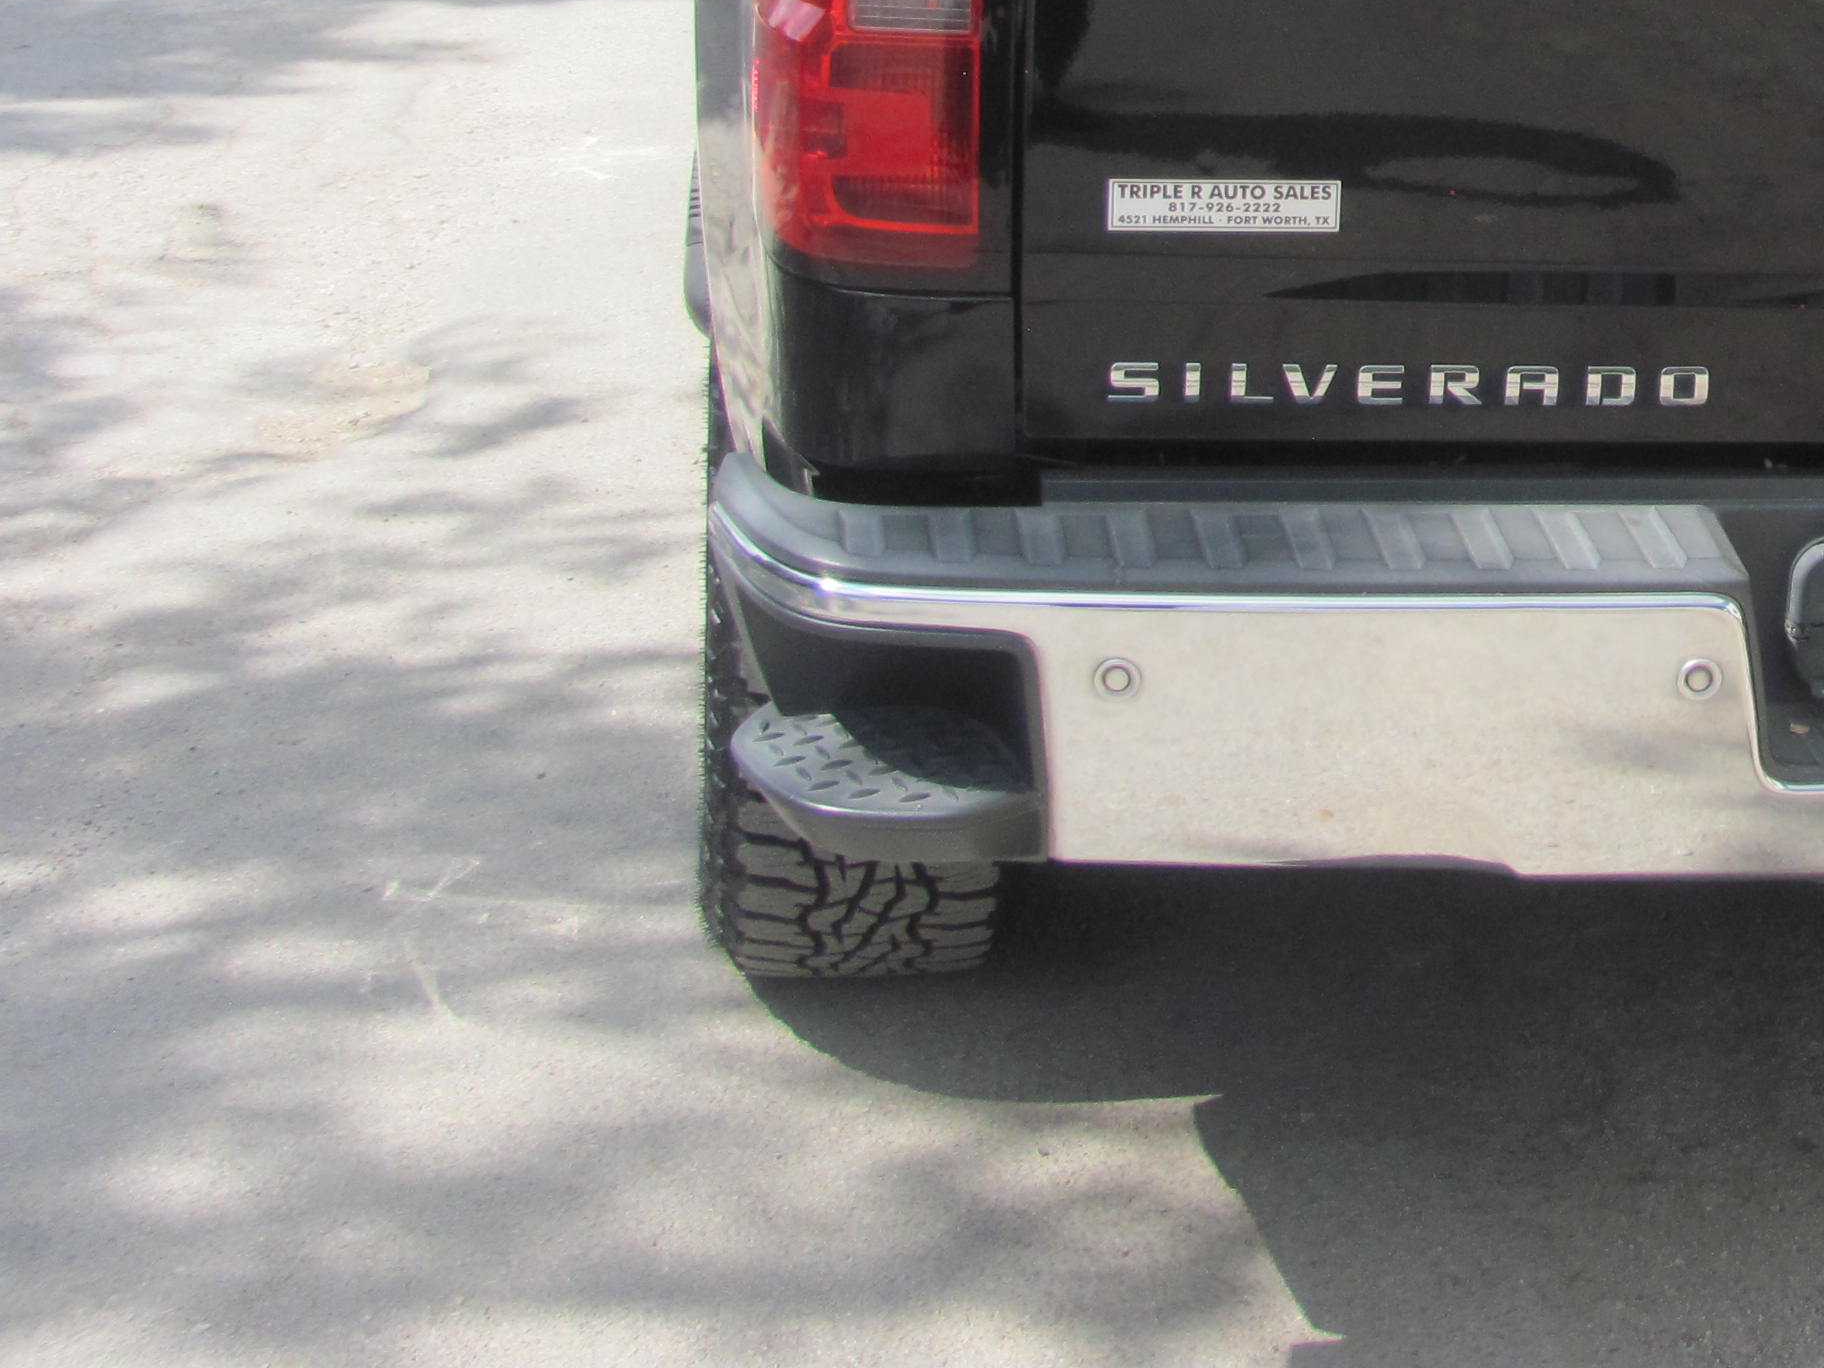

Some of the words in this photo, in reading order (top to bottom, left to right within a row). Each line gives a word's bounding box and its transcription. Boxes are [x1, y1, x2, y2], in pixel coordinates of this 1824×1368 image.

[1117, 184, 1183, 199] TRIPLE
[1191, 184, 1203, 200] R
[1209, 184, 1266, 200] AUTO
[1273, 185, 1332, 200] SALES
[1168, 202, 1281, 213] 817-926-2222
[1118, 215, 1147, 225] 4521
[1152, 215, 1214, 225] HEMPHILL
[1227, 215, 1258, 225] FORT
[1261, 216, 1312, 226] WORTH,
[1315, 216, 1330, 226] TX
[1107, 362, 1711, 406] SILVERADO
